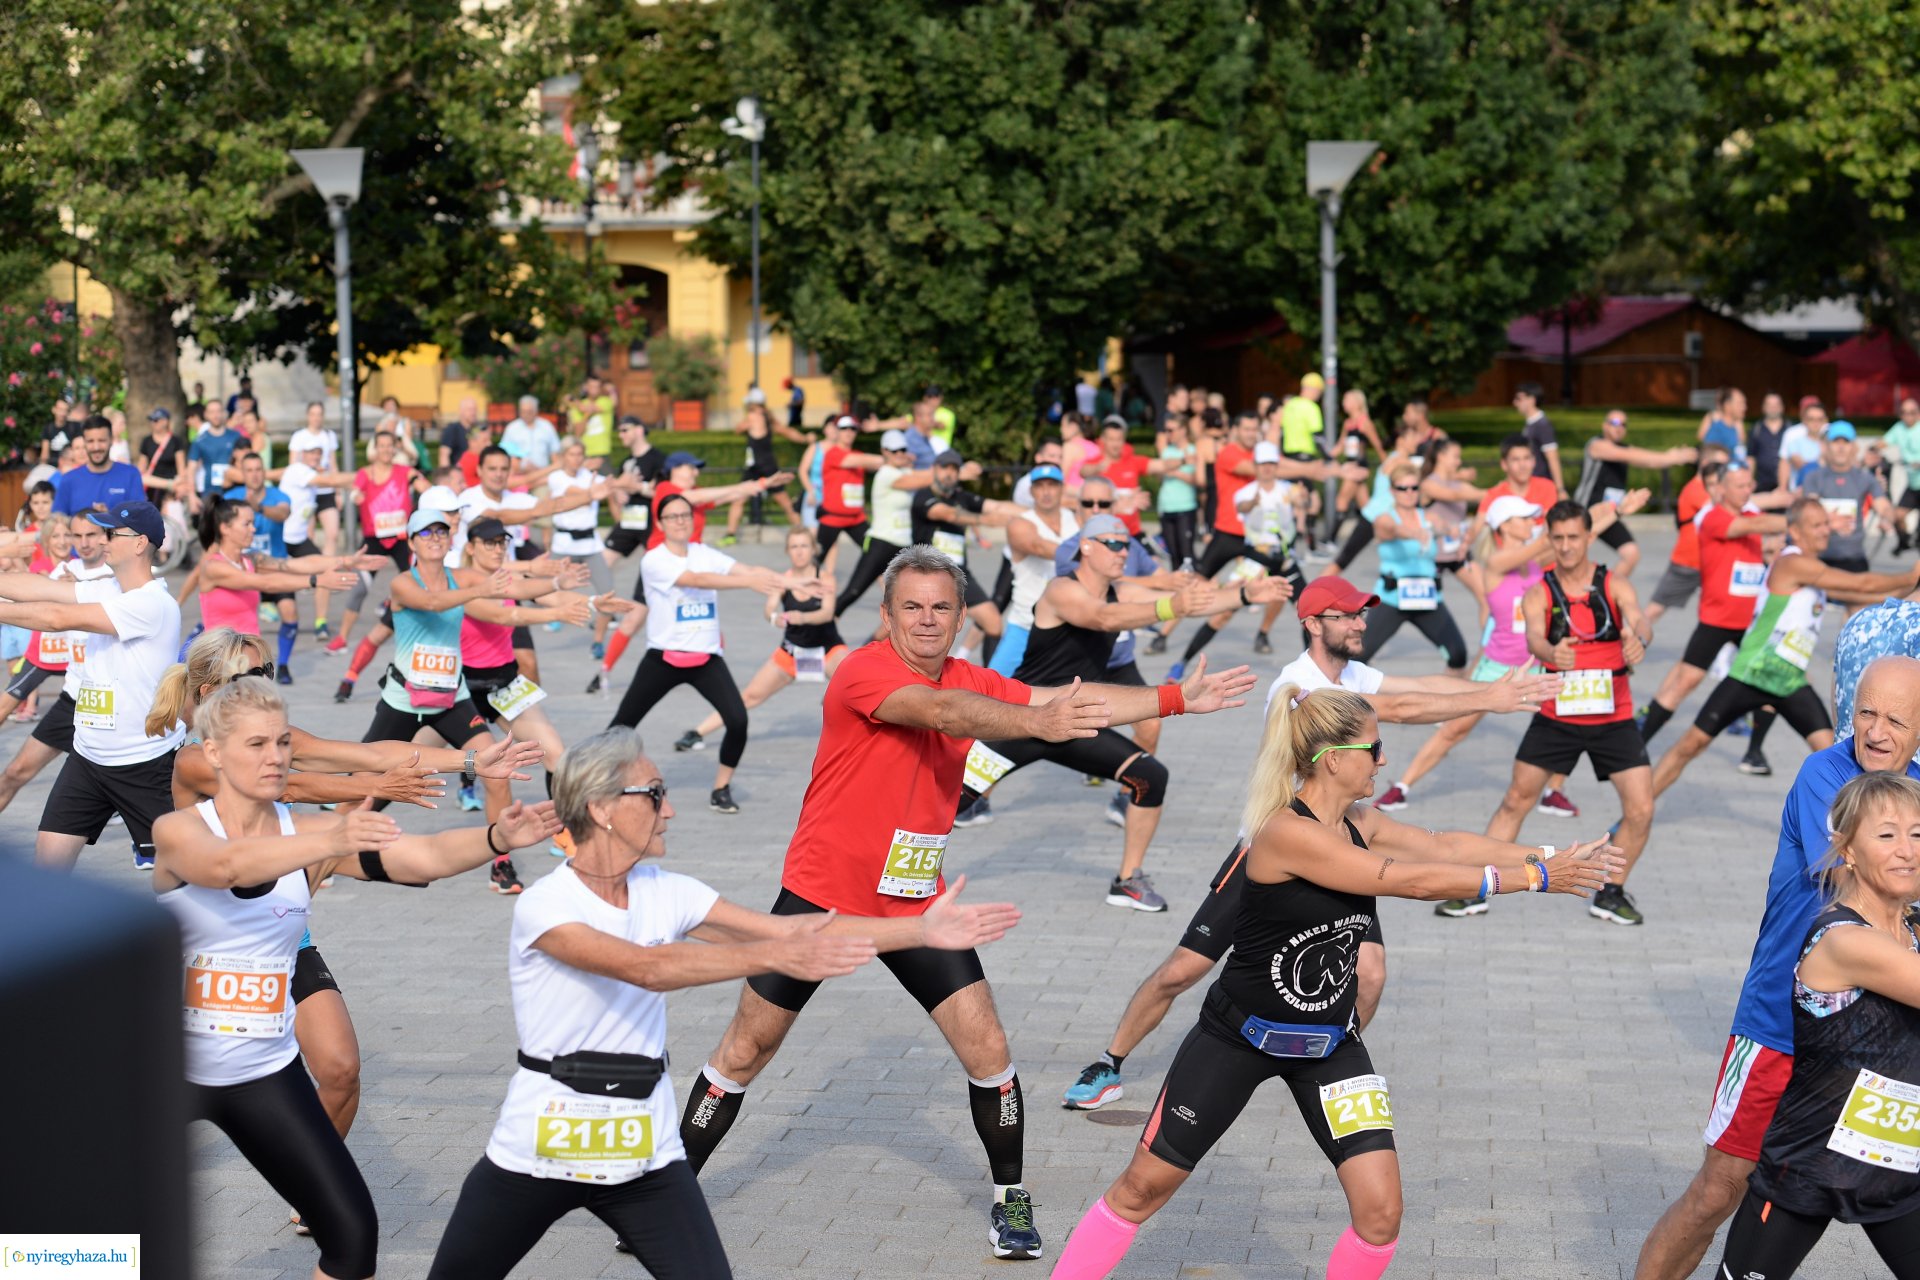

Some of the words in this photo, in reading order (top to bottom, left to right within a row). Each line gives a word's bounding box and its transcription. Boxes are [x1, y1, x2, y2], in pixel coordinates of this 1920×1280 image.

[681, 604, 709, 618] 608
[416, 654, 455, 671] 1010
[78, 689, 106, 709] 2151
[1562, 679, 1606, 697] 2314
[966, 749, 1005, 779] 2336
[1289, 924, 1329, 948] NAKED
[1270, 953, 1284, 981] CSAK
[195, 972, 279, 1003] 1059
[1273, 981, 1285, 990] A
[699, 1104, 717, 1129] SPORT
[1009, 1097, 1018, 1126] SPORT
[1334, 1092, 1393, 1124] 213
[546, 1118, 643, 1149] 2119
